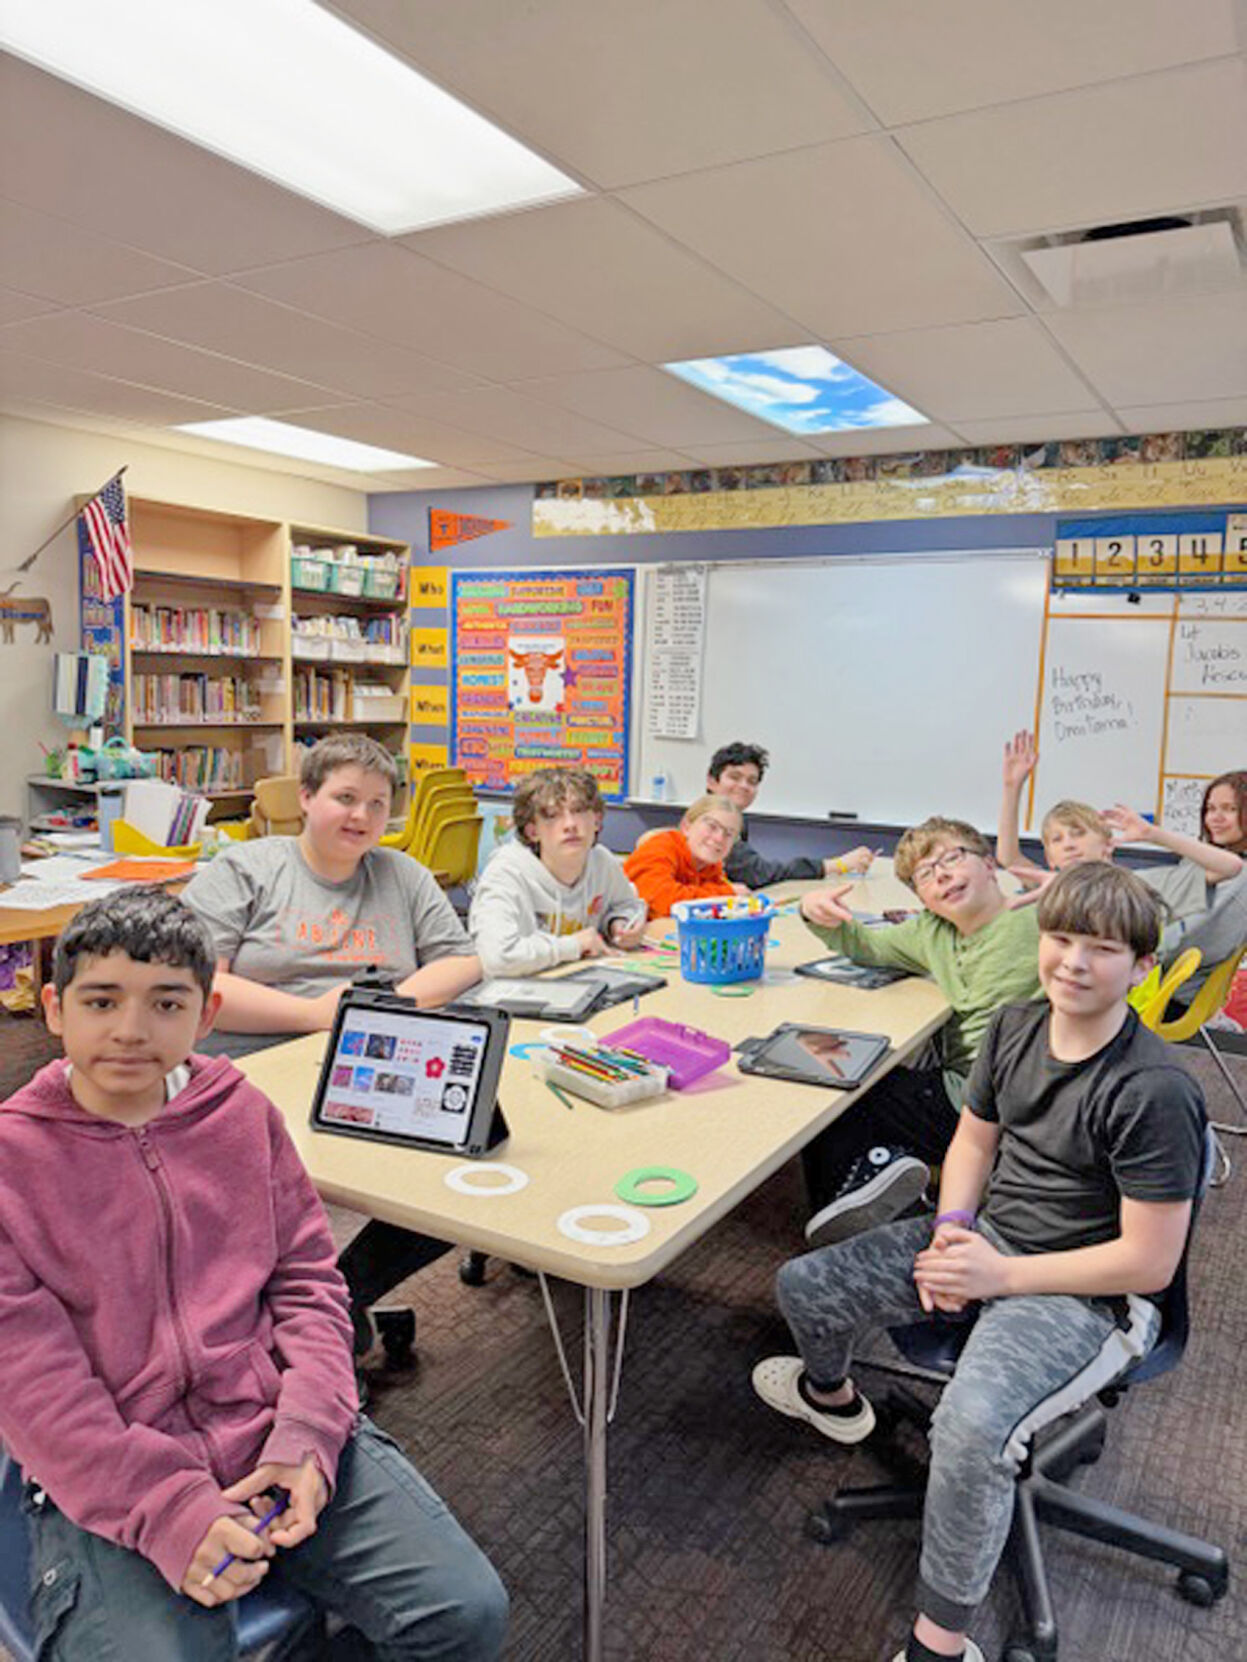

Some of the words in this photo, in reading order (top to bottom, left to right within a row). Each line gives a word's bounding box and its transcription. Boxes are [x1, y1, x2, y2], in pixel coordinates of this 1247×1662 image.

[1072, 543, 1078, 568] 1
[1108, 542, 1122, 567] 2
[1149, 540, 1164, 567] 3
[1191, 538, 1208, 564] 4
[1051, 666, 1102, 694] Happy
